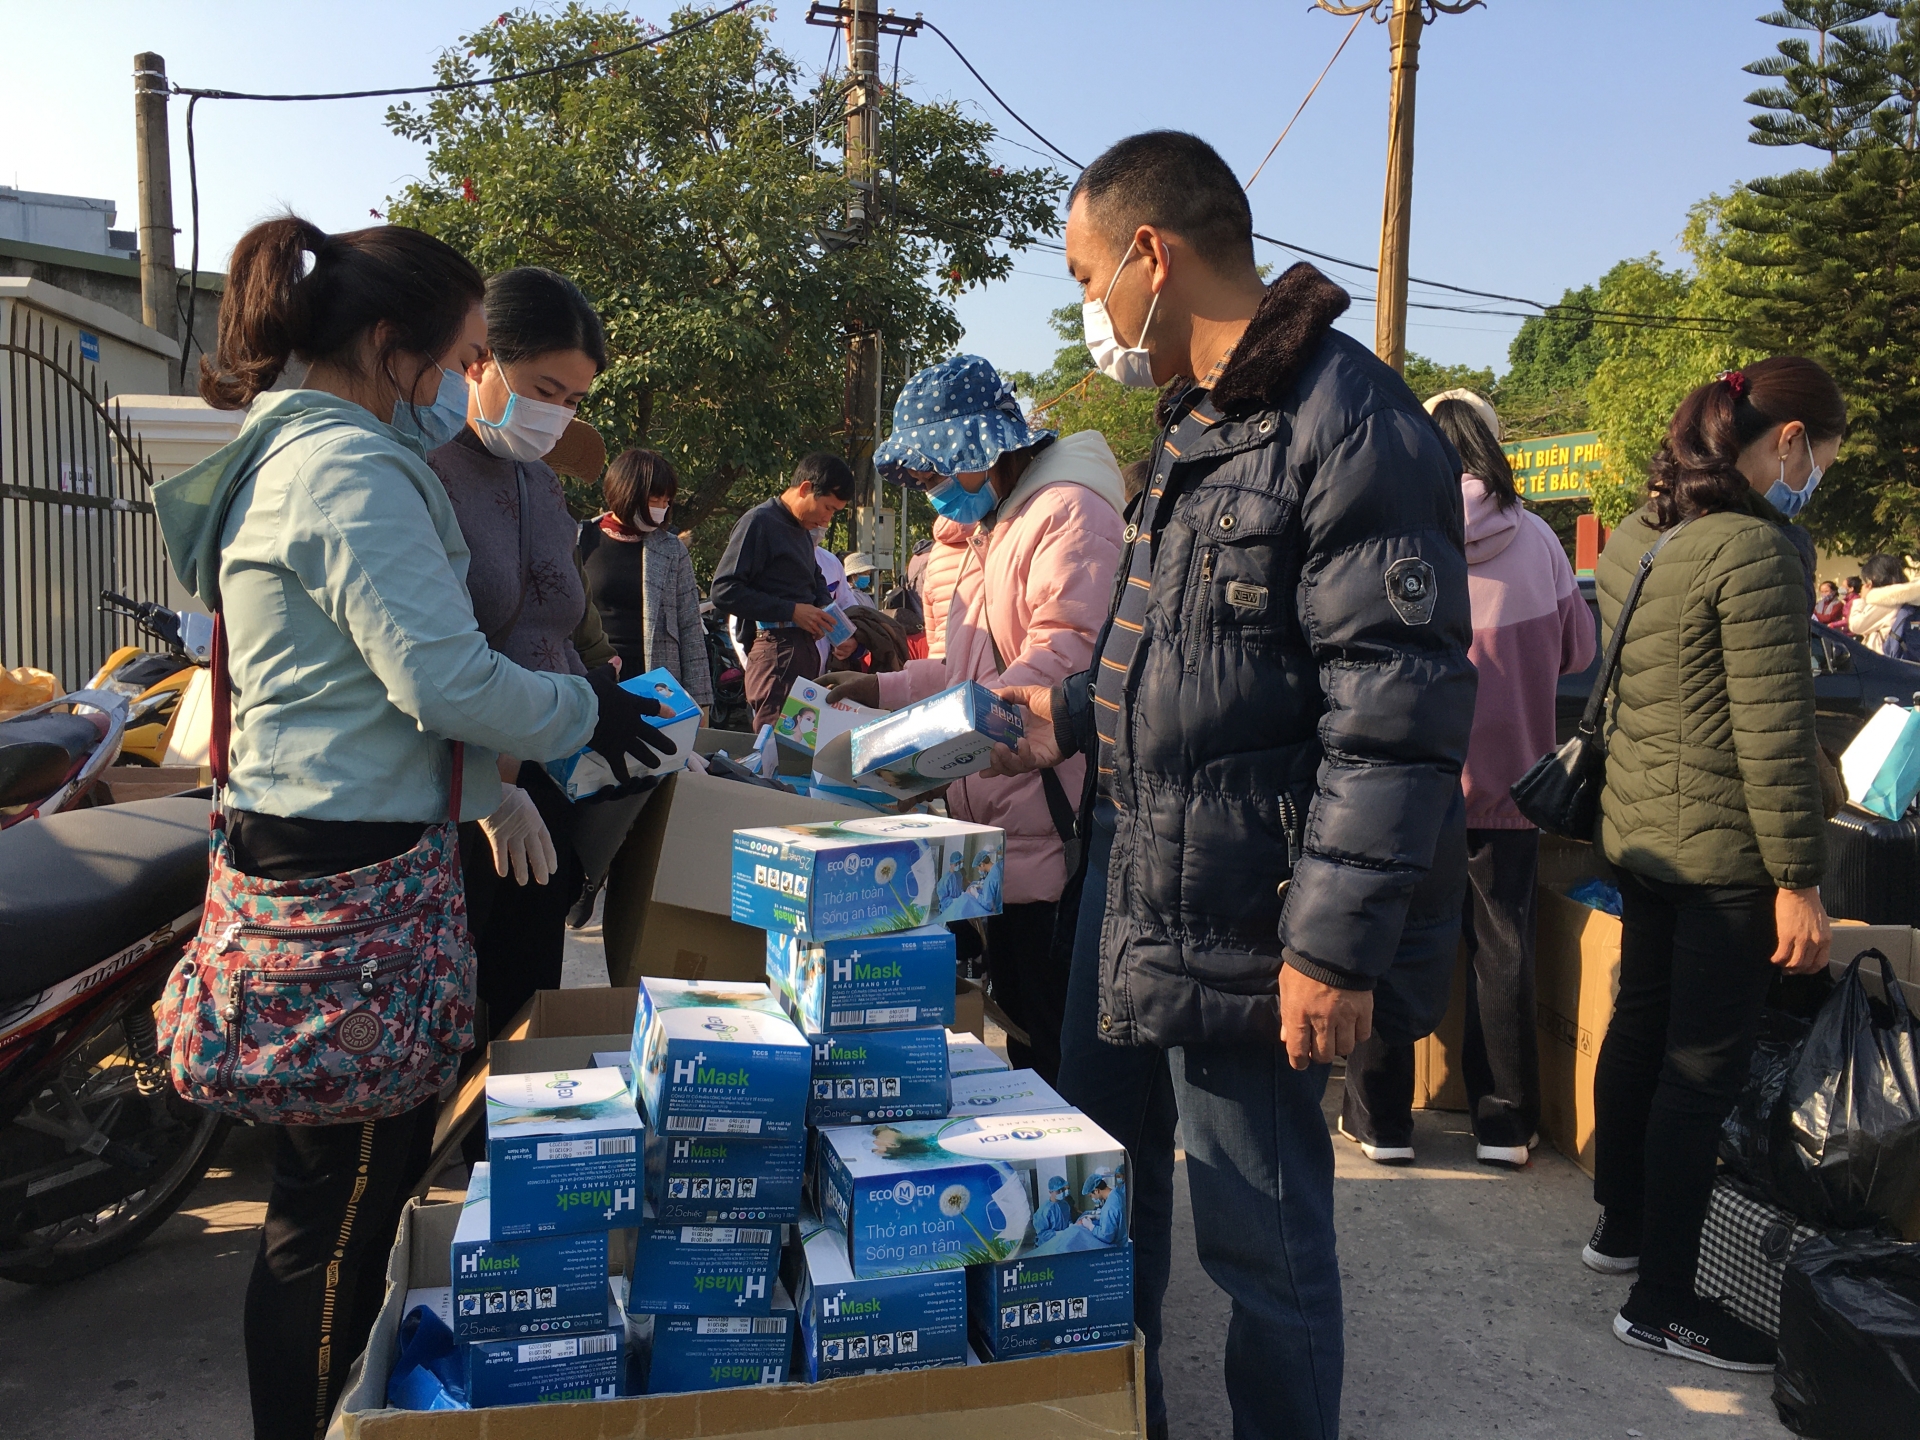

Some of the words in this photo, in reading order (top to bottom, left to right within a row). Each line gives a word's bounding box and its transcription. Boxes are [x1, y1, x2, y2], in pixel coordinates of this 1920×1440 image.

[1507, 449, 1532, 470] OÁT
[1535, 444, 1570, 468] BIÊN
[1530, 469, 1548, 493] TẾ
[1550, 466, 1579, 491] BẮC
[1234, 590, 1258, 603] NEW
[827, 853, 874, 876] ECOMEDI
[823, 891, 845, 906] Thở
[846, 889, 859, 901] an
[861, 885, 884, 900] toàn
[822, 906, 849, 926] Sống
[851, 908, 865, 920] an
[866, 903, 888, 918] tâm
[979, 1126, 1083, 1145] ECOMEDI
[869, 1180, 935, 1206] ECOMEDI
[865, 1222, 896, 1241] Thở
[899, 1222, 918, 1237] an
[921, 1217, 955, 1234] toàn
[866, 1241, 905, 1261] Sống
[909, 1243, 927, 1256] an
[932, 1239, 961, 1253] tâm
[327, 1262, 339, 1287] ASHION
[1668, 1322, 1710, 1347] GUCCI
